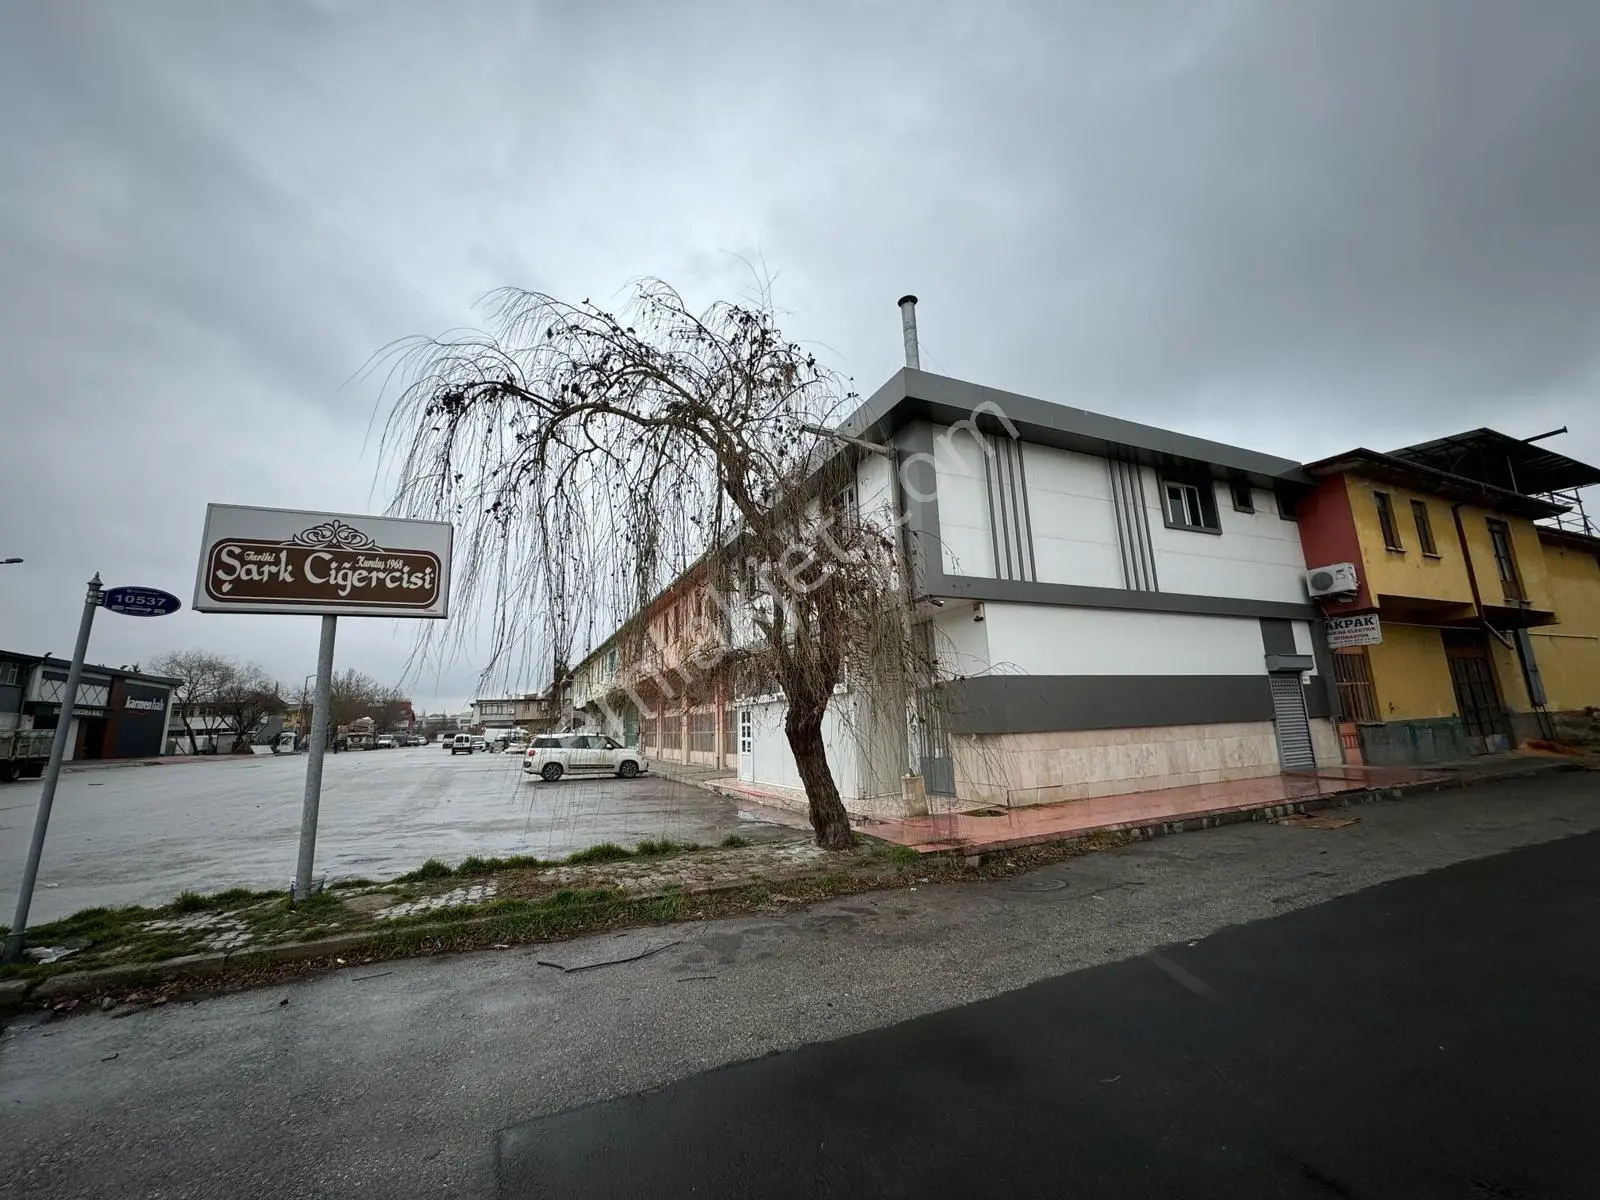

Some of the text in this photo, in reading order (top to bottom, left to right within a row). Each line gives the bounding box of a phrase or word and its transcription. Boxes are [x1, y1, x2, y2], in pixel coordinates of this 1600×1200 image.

[244, 551, 276, 562] Tarihi
[216, 546, 433, 597] Şark Ciğercisi
[114, 594, 167, 606] 10537
